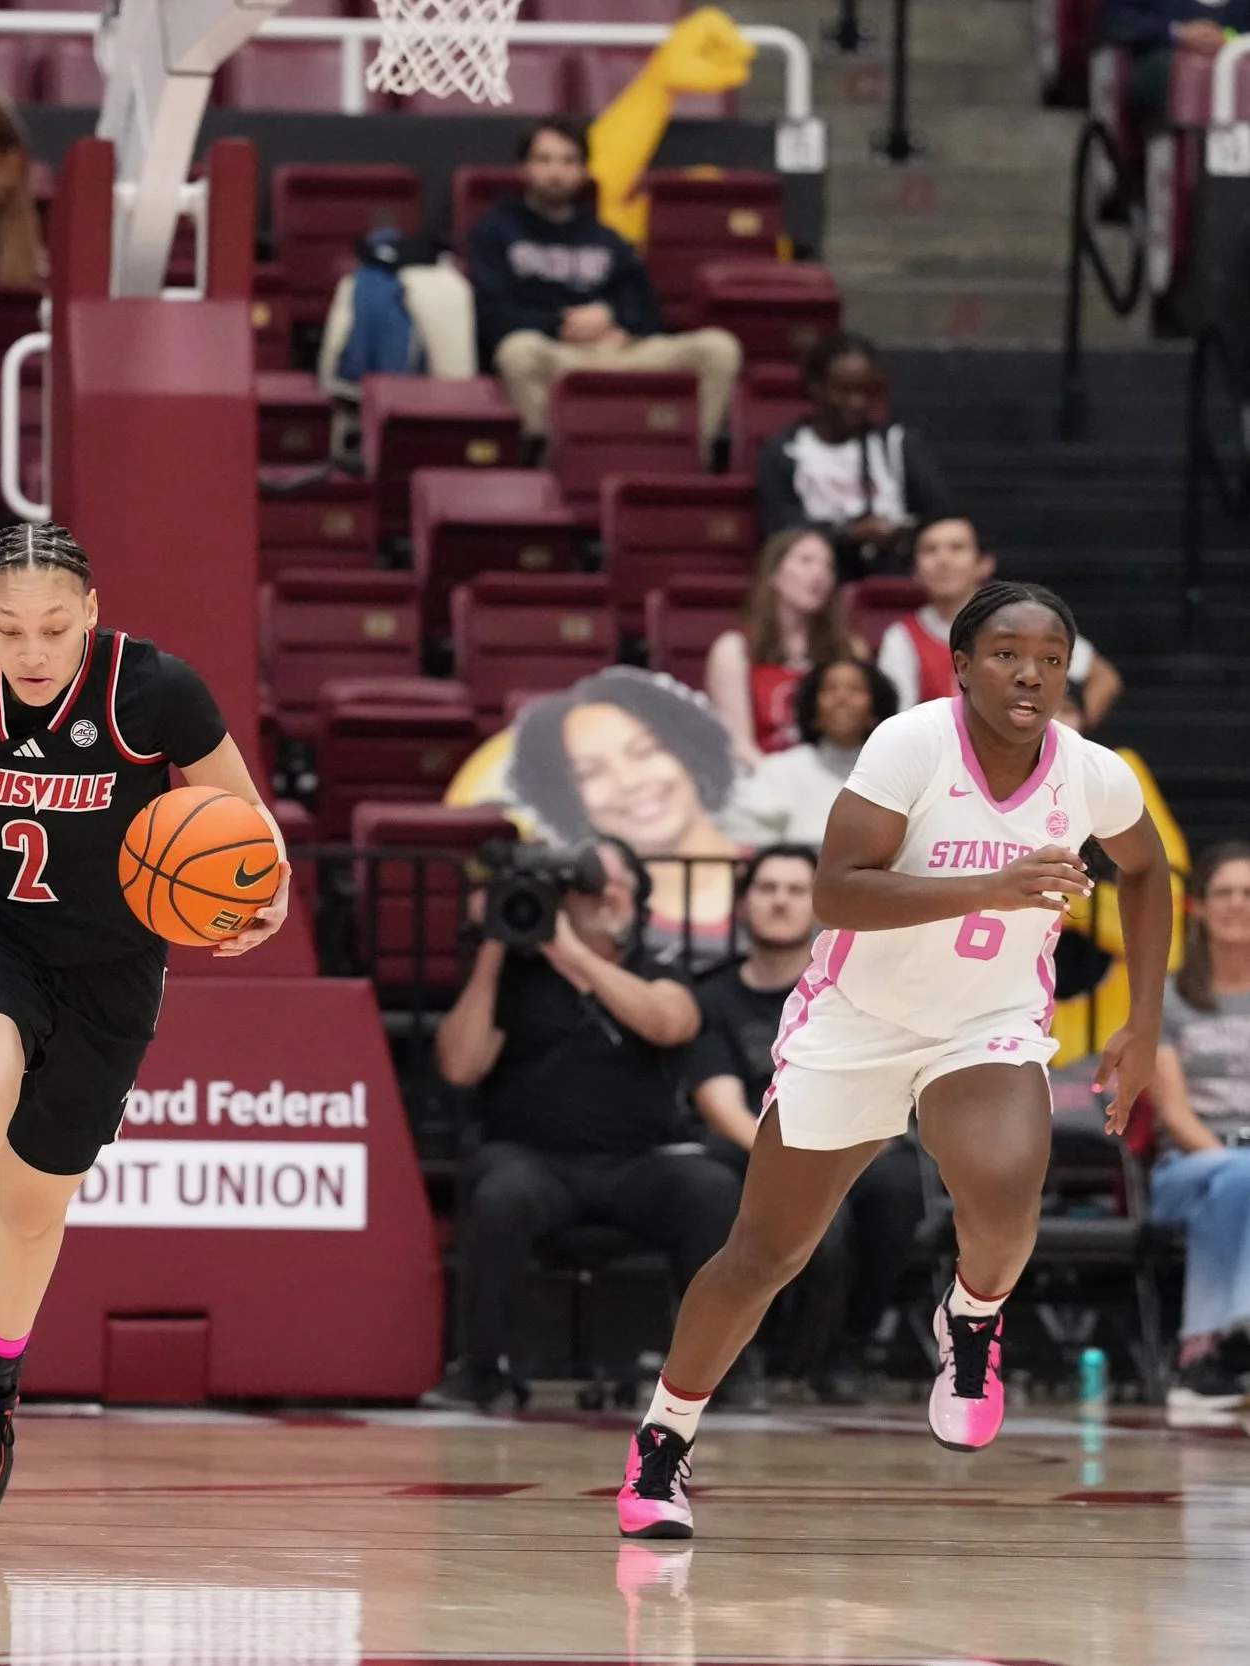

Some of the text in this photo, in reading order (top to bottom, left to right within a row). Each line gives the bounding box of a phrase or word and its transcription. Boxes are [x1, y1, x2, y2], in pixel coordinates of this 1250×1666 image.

[1, 819, 60, 903] 2
[954, 909, 1007, 961] 6
[207, 1079, 368, 1128] Federal
[177, 1162, 346, 1208] UNION
